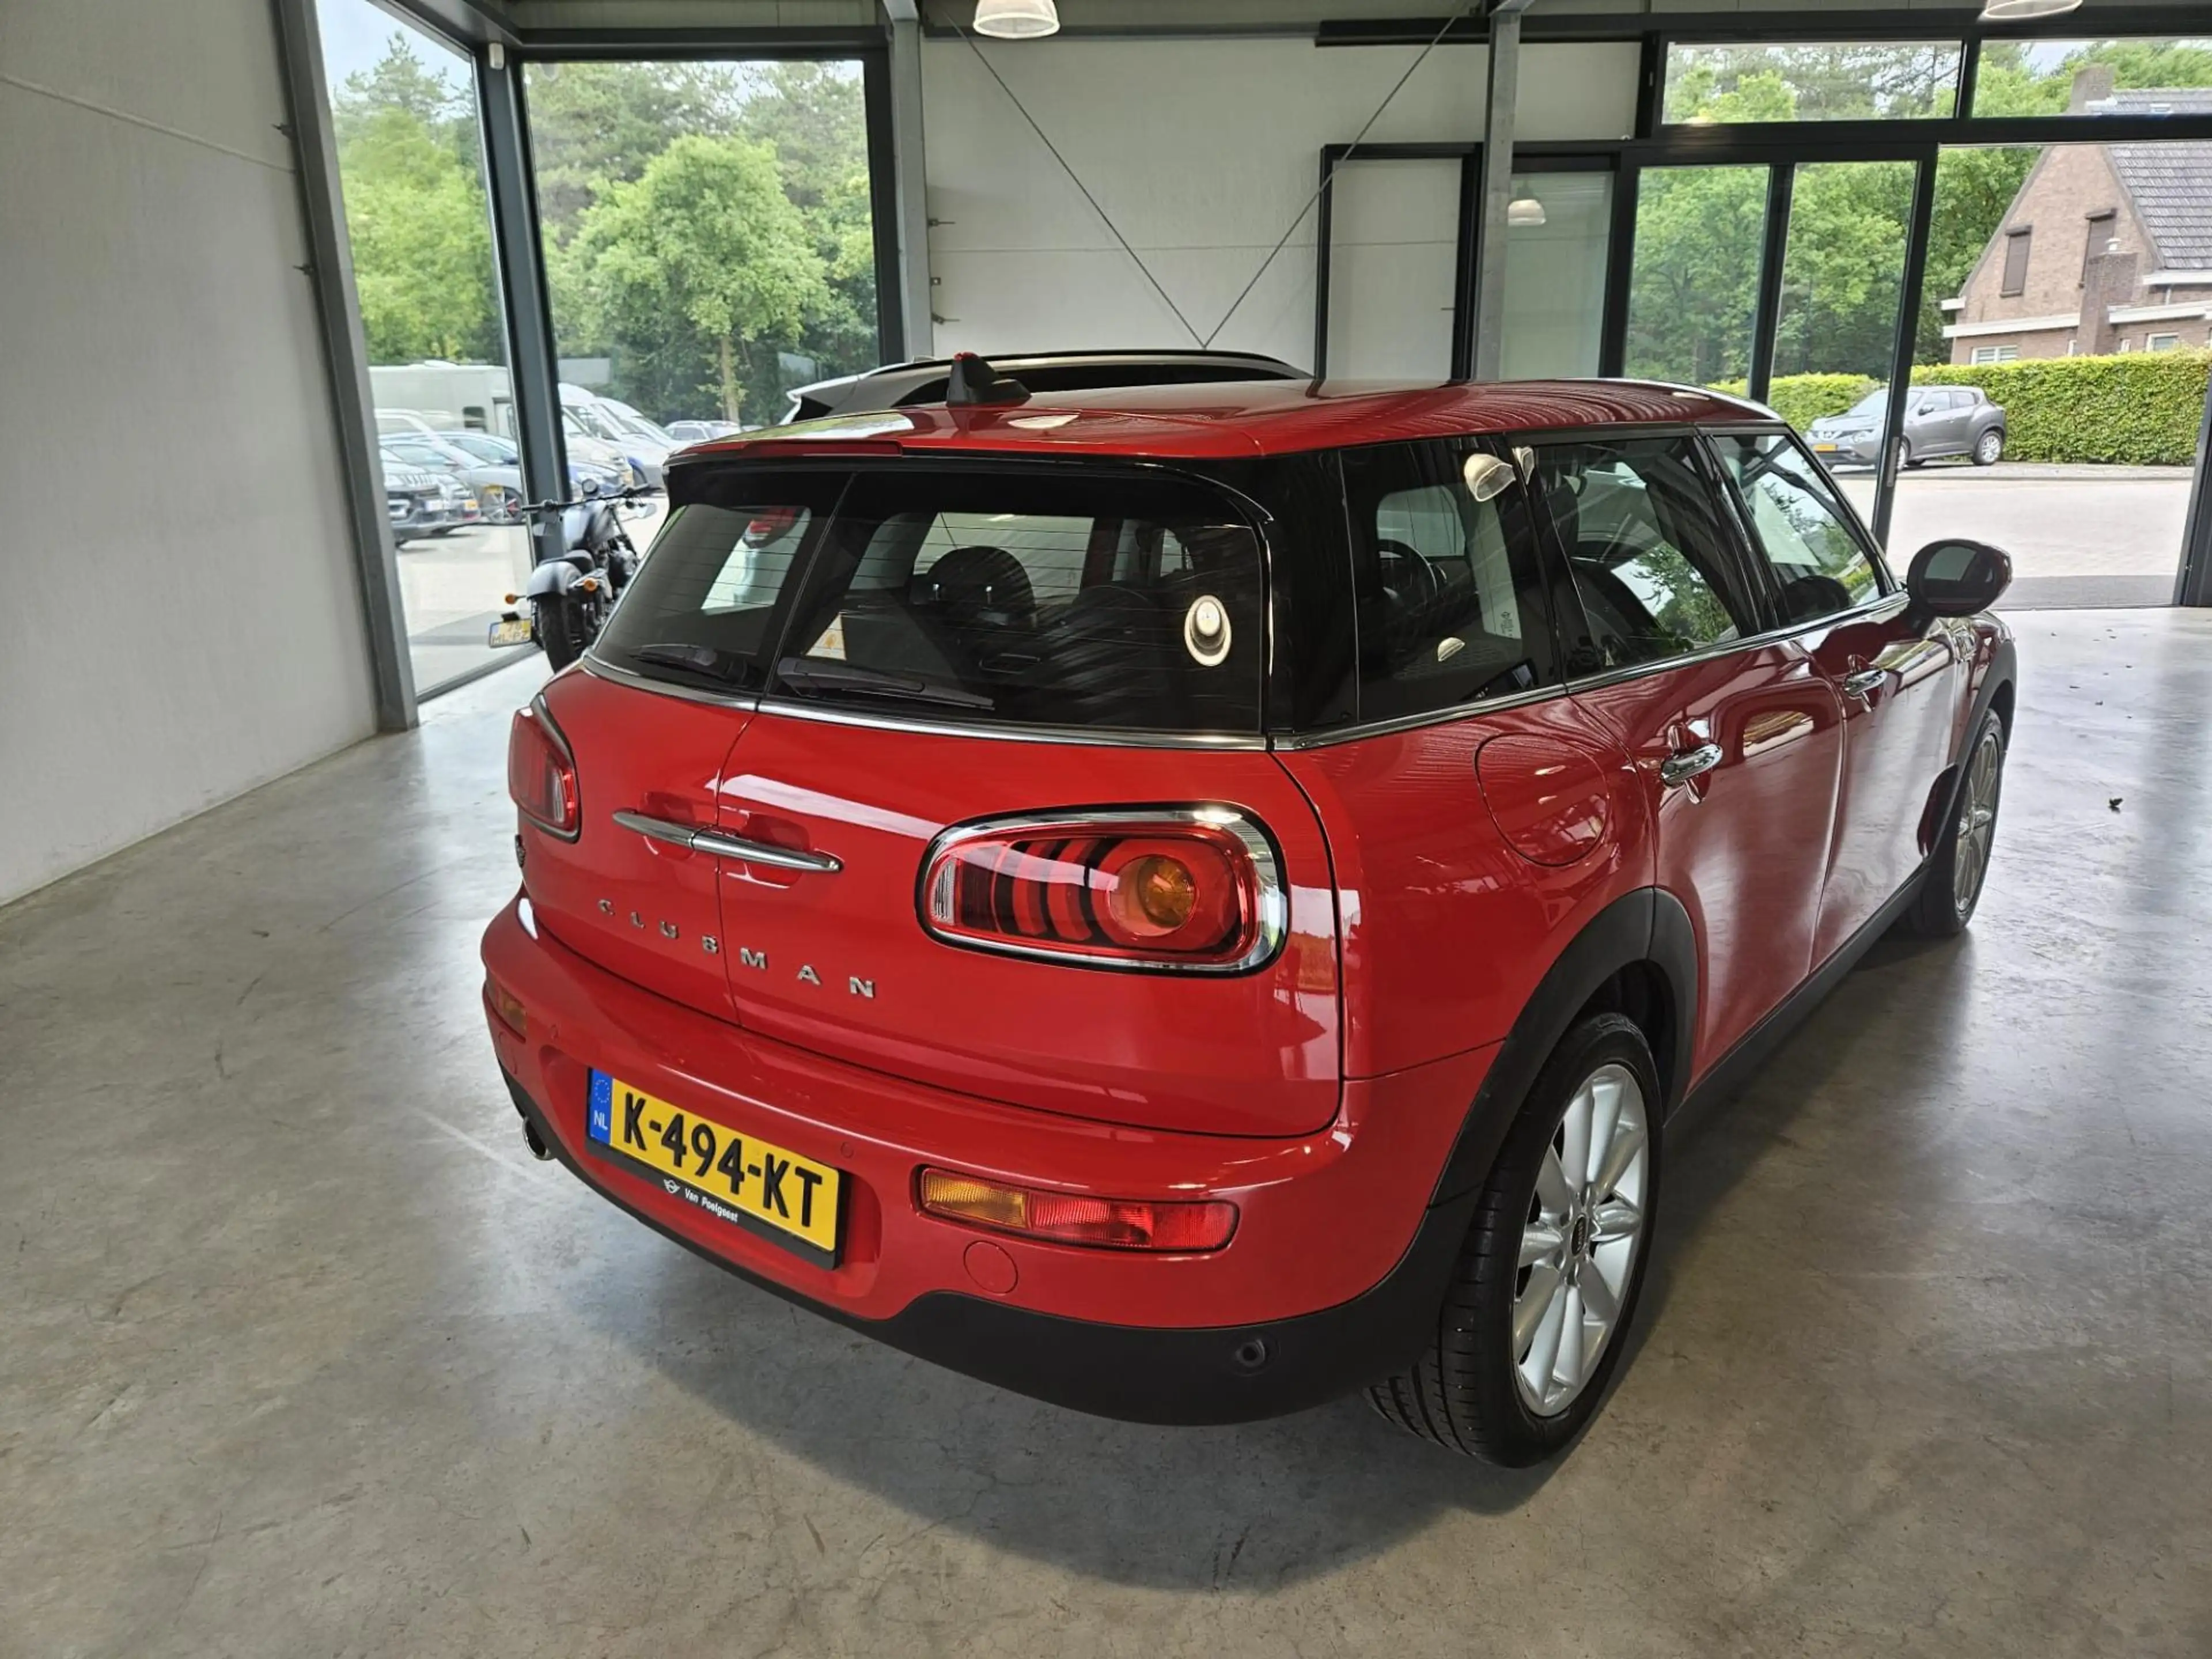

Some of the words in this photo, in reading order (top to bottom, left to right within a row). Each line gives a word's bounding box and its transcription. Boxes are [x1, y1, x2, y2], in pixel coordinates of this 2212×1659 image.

[597, 899, 876, 999] CLUBMAN
[594, 1109, 608, 1130] NL
[623, 1091, 823, 1228] K-494-KT
[684, 1187, 699, 1203] Van
